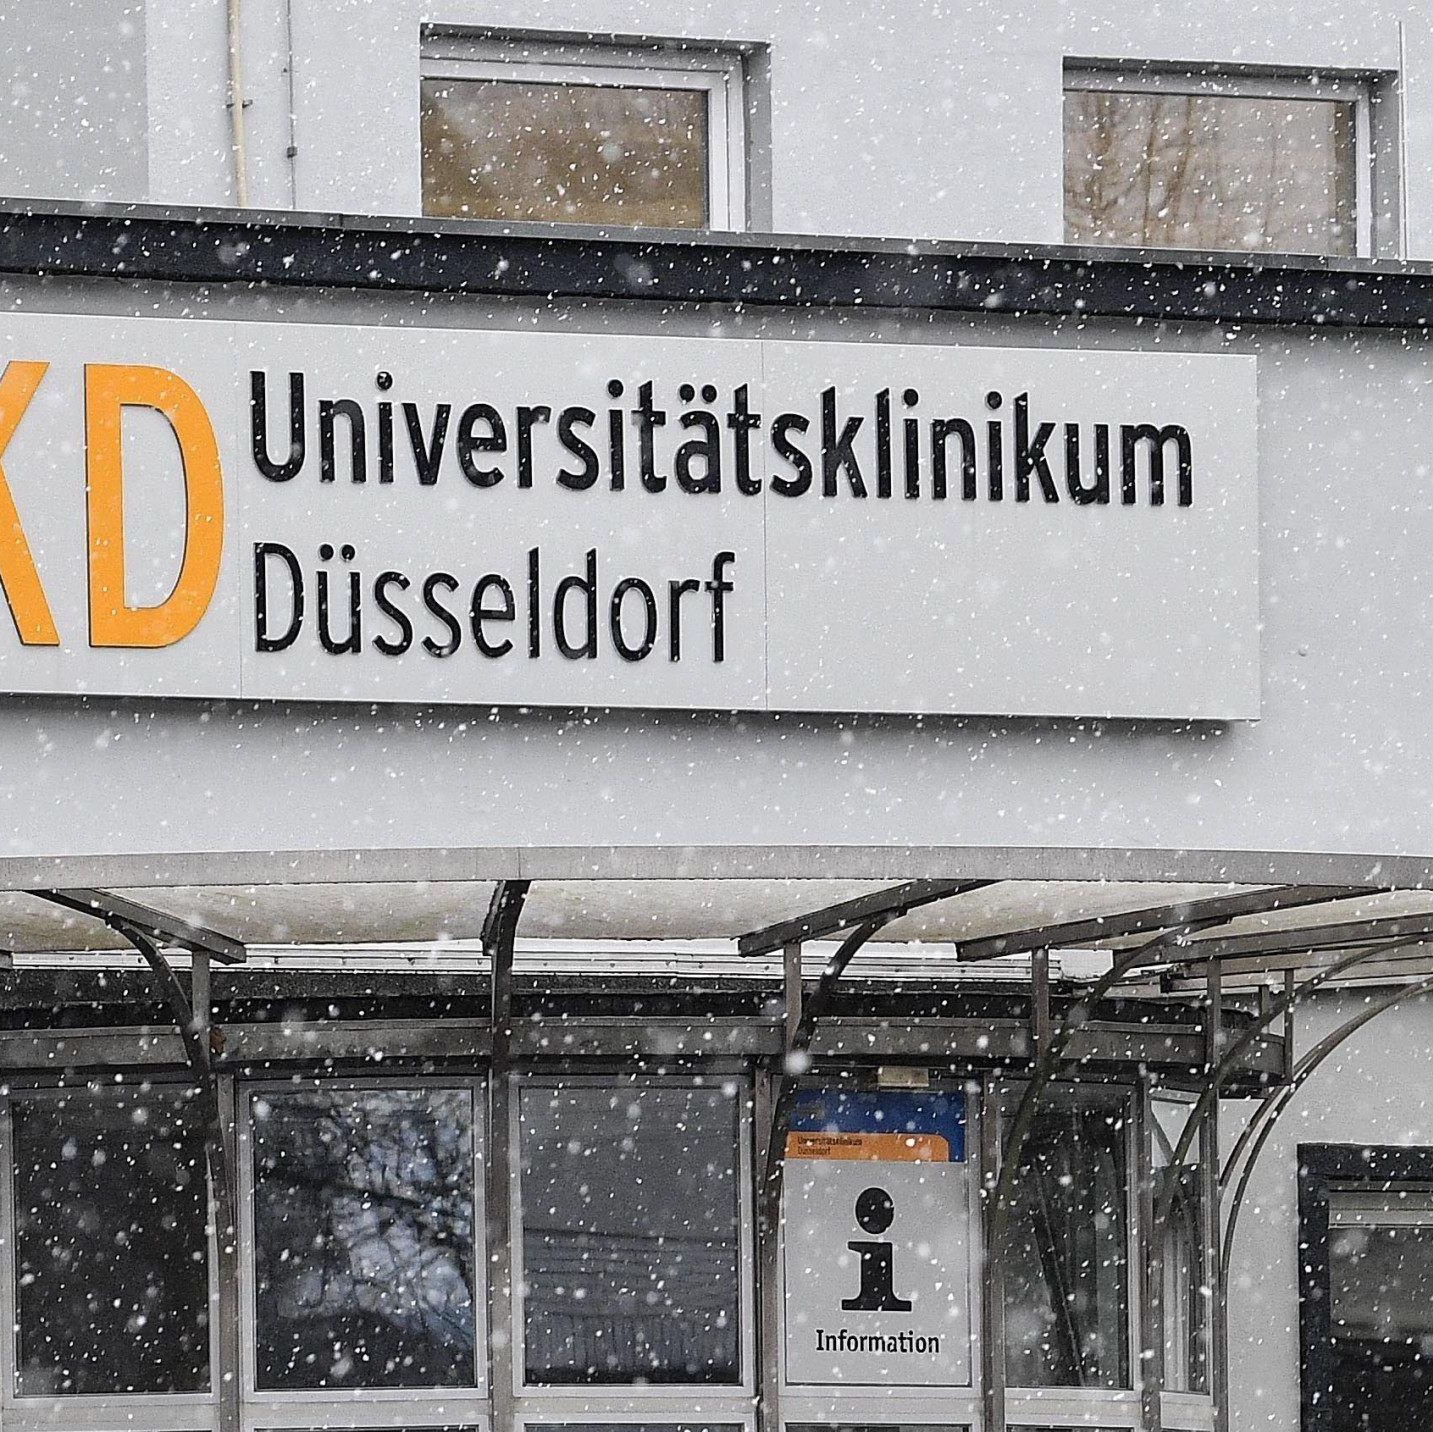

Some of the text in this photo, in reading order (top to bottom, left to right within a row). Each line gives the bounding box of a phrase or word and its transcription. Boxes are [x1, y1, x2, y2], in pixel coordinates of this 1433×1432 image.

[250, 371, 1193, 506] Universitätsklinikum
[253, 541, 735, 662] Düsseldorf
[816, 1329, 939, 1353] Information
